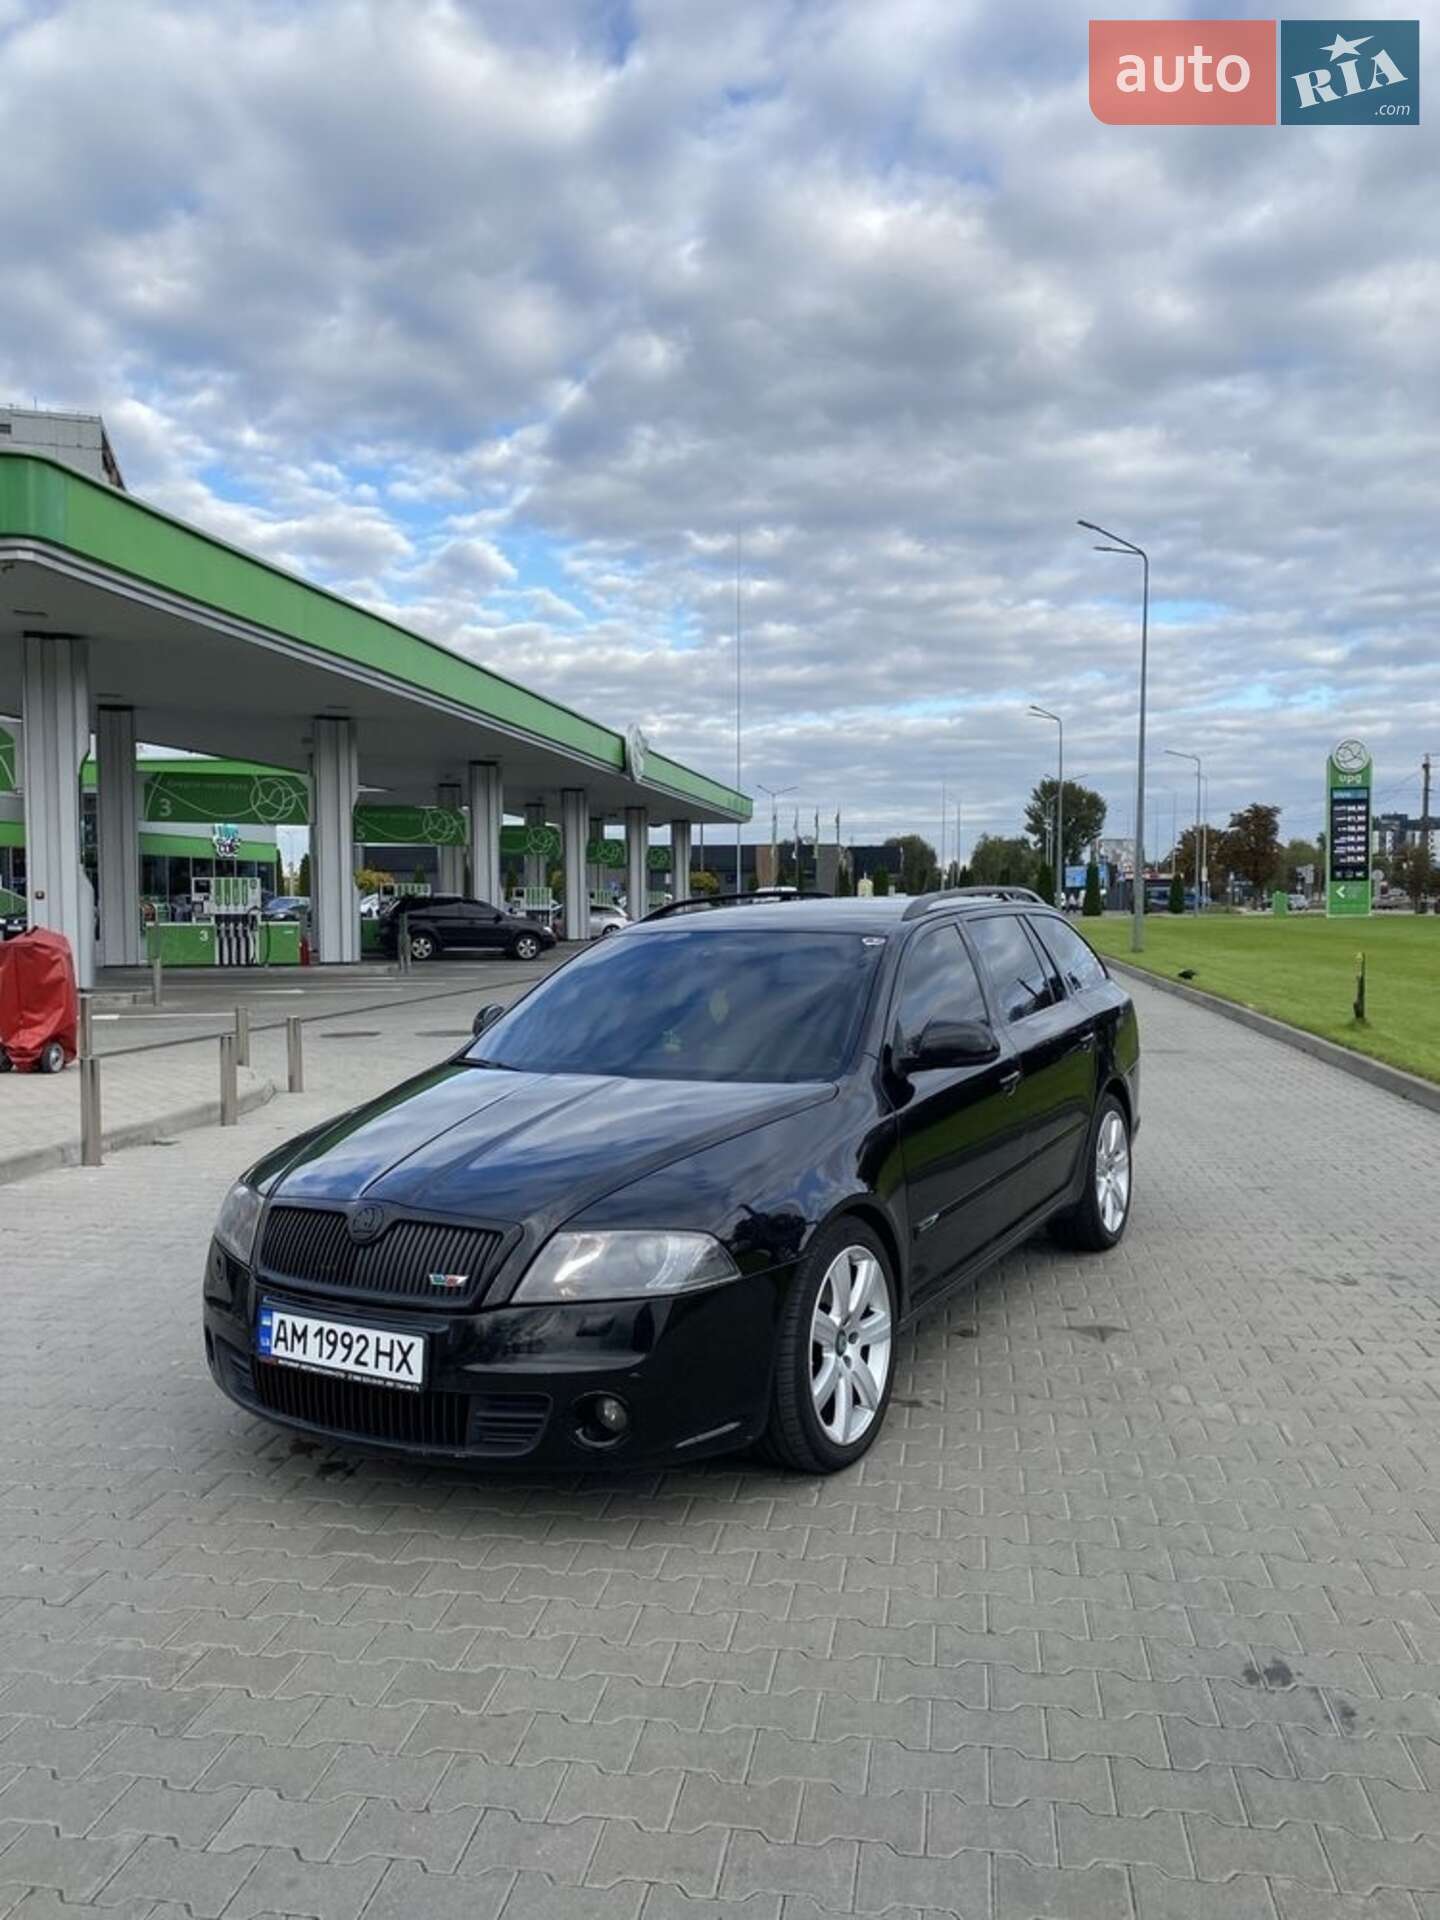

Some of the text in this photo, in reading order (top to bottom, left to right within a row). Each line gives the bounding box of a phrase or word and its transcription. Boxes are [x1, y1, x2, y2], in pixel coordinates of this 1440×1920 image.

[159, 799, 172, 817] 3
[200, 930, 209, 941] 3
[274, 1319, 308, 1355] AM
[313, 1326, 369, 1367] 1992
[374, 1336, 415, 1375] HX
